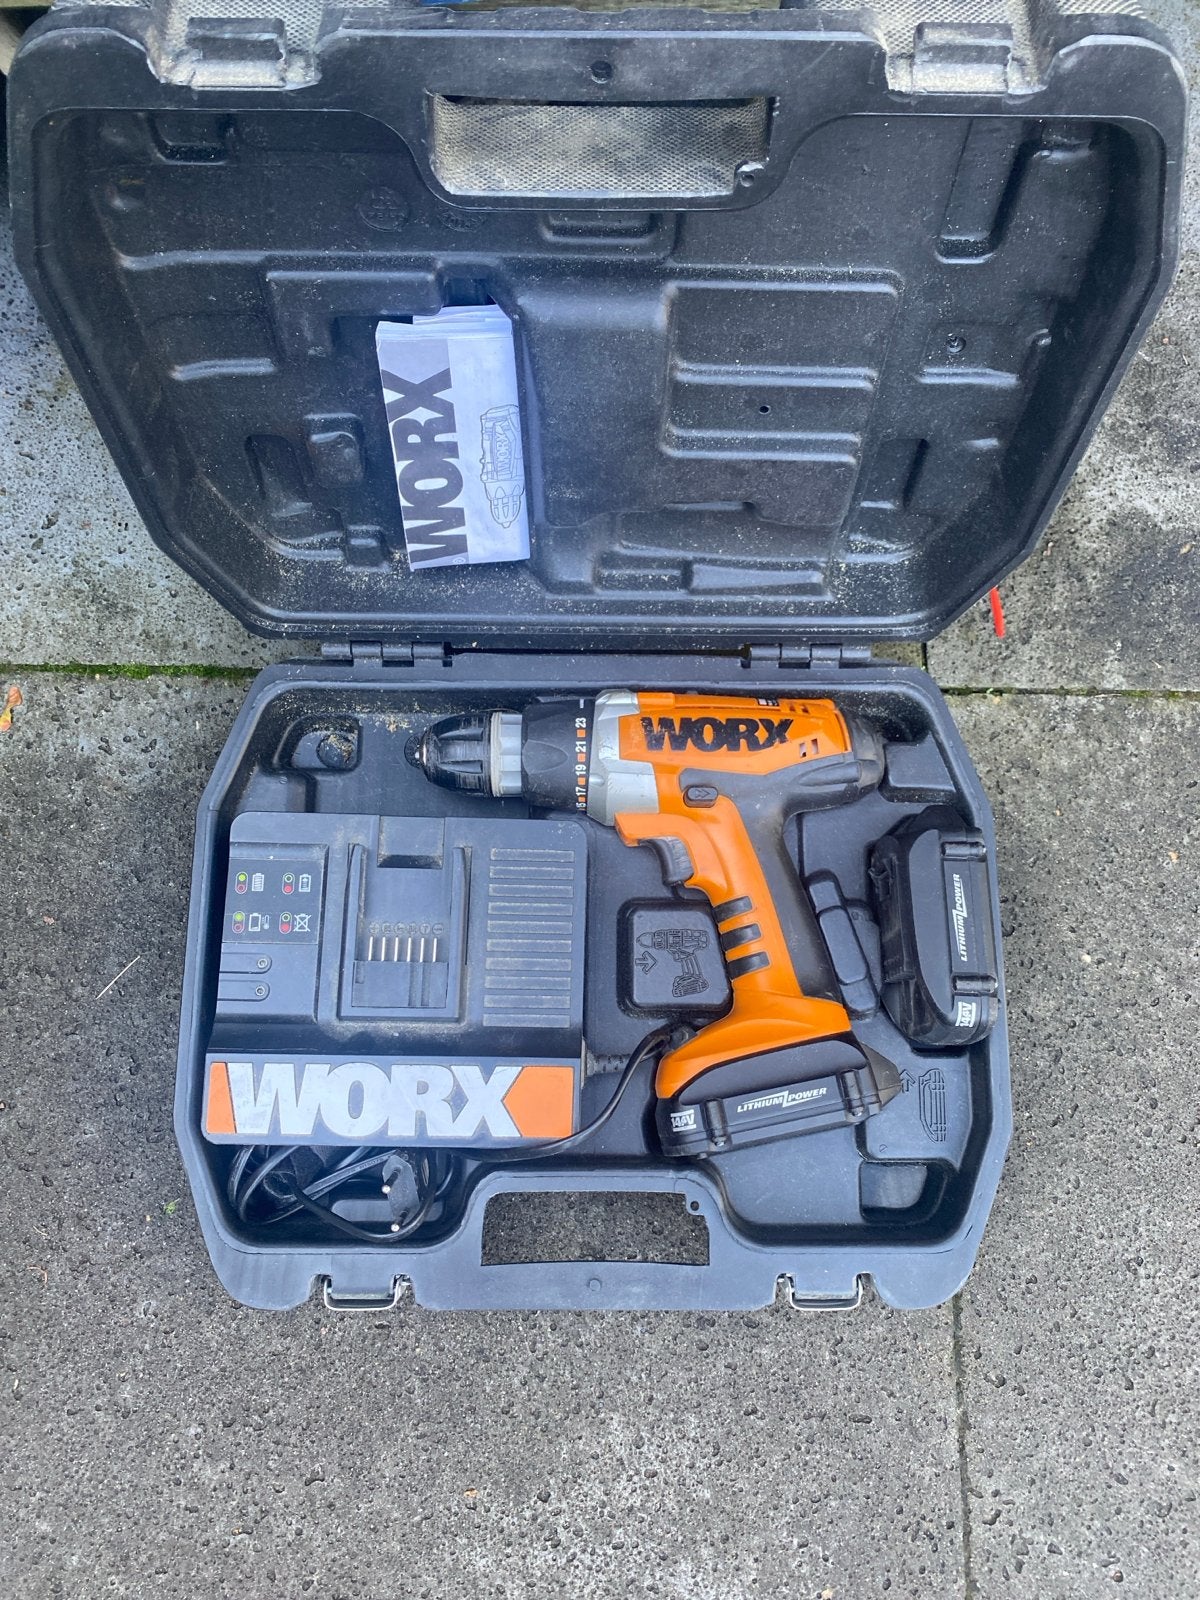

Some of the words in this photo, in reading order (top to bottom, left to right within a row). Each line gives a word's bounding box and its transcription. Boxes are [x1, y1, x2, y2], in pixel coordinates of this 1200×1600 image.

[381, 367, 468, 563] WORX
[575, 717, 587, 728] 23
[640, 716, 794, 753] WORX
[575, 741, 587, 753] 21
[575, 764, 587, 776] 19
[575, 786, 587, 796] 17
[952, 873, 964, 912] POWER
[955, 913, 968, 962] LITHIUM
[227, 1062, 524, 1137] WORX
[736, 1096, 783, 1113] LITHIUM
[787, 1087, 827, 1102] POWER
